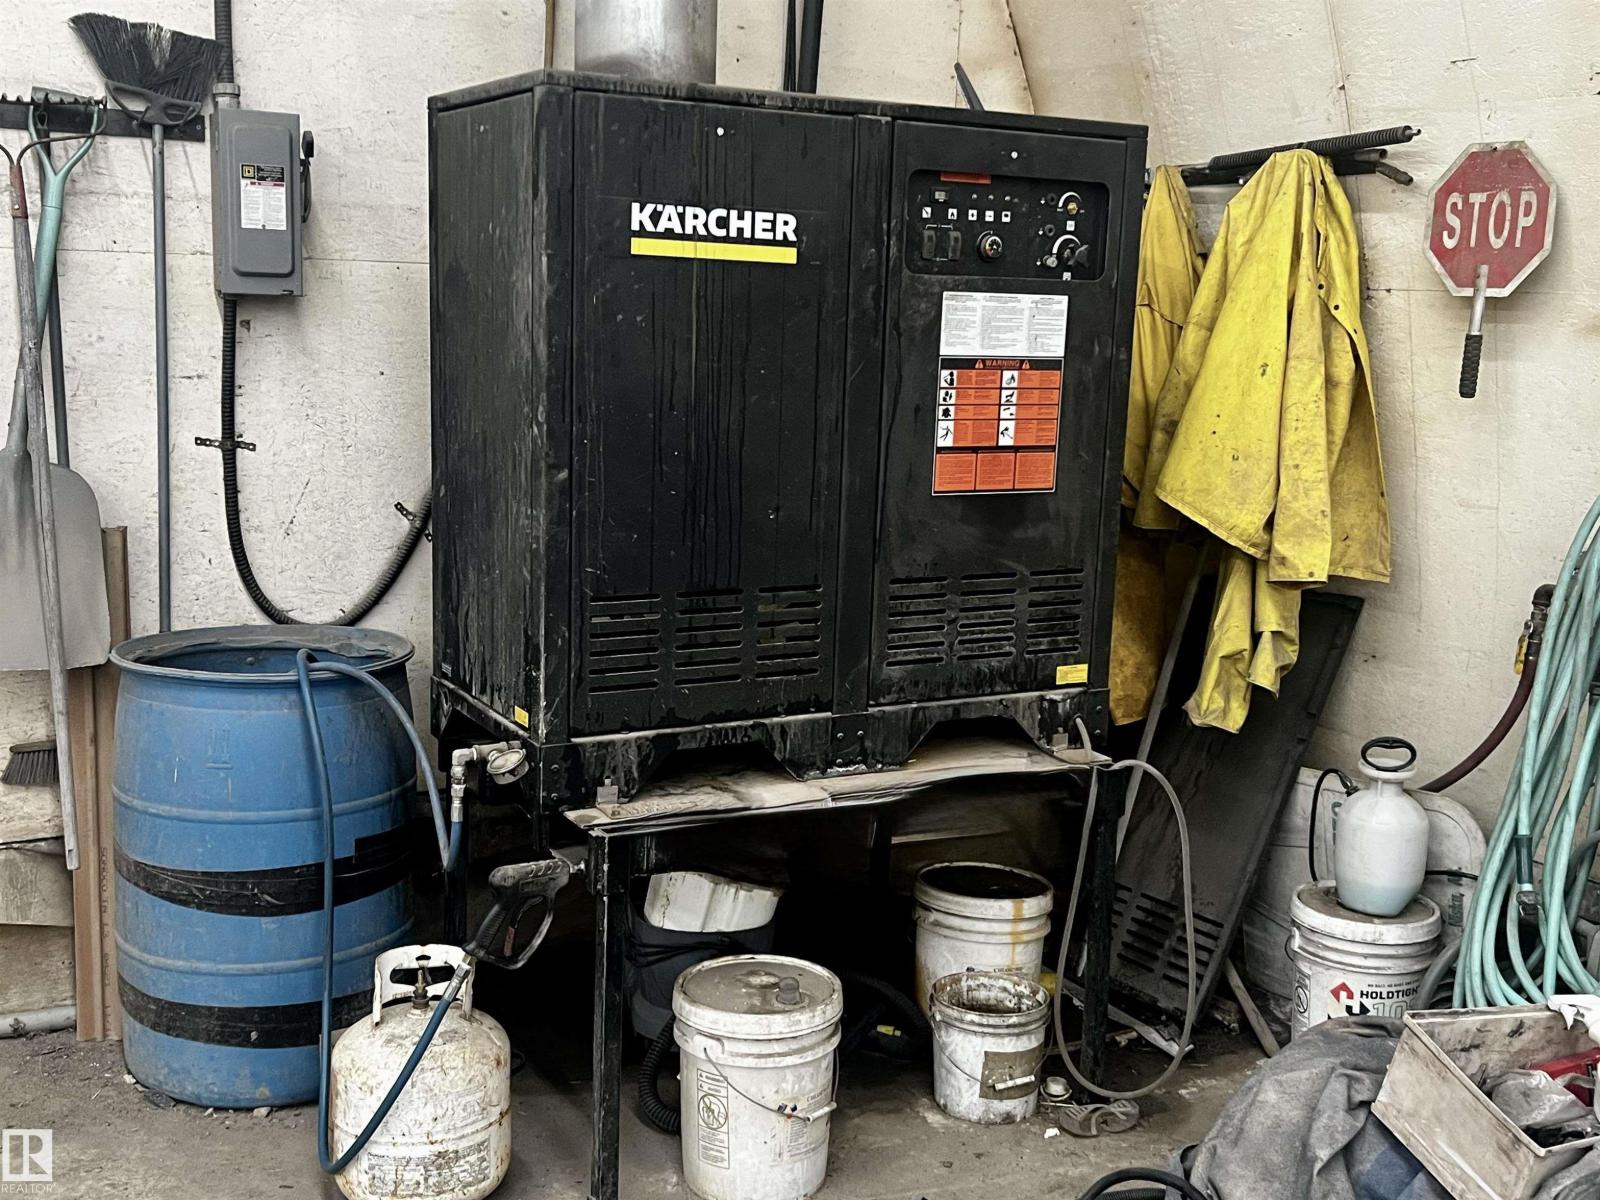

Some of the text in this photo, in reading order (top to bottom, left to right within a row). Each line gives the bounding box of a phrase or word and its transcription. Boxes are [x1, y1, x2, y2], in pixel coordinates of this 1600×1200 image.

[630, 202, 798, 242] KÄRCHER
[1442, 190, 1538, 250] STOP
[985, 359, 1020, 367] WARNING
